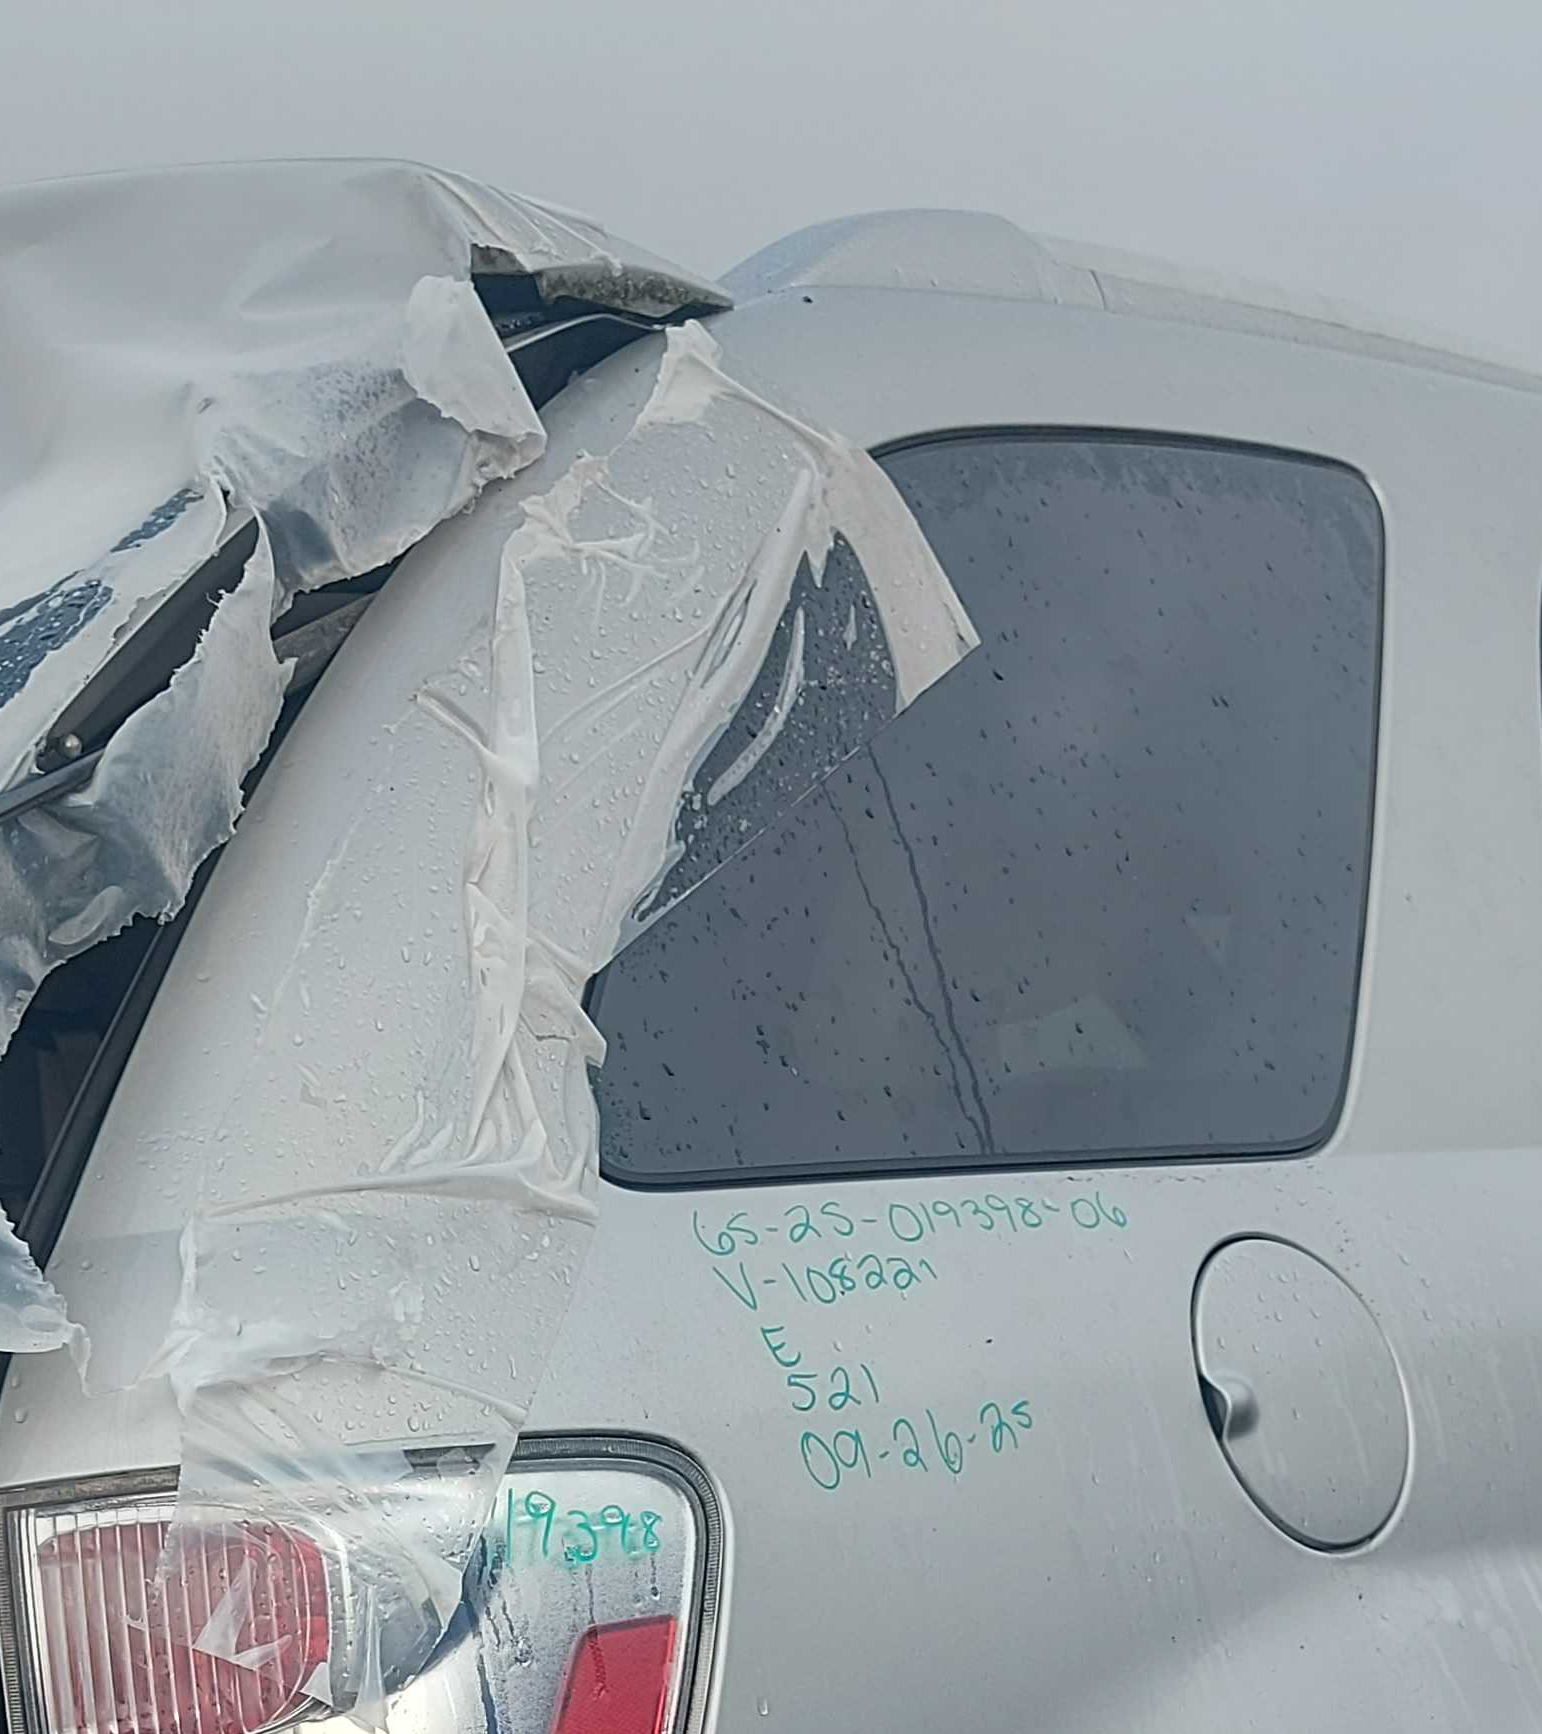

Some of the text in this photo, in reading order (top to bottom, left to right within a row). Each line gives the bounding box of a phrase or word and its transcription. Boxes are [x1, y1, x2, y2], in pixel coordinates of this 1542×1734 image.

[760, 1326, 801, 1367] E
[787, 1363, 879, 1411] 521
[800, 1400, 1033, 1489] 09-26-25
[506, 1487, 663, 1563] 19398
